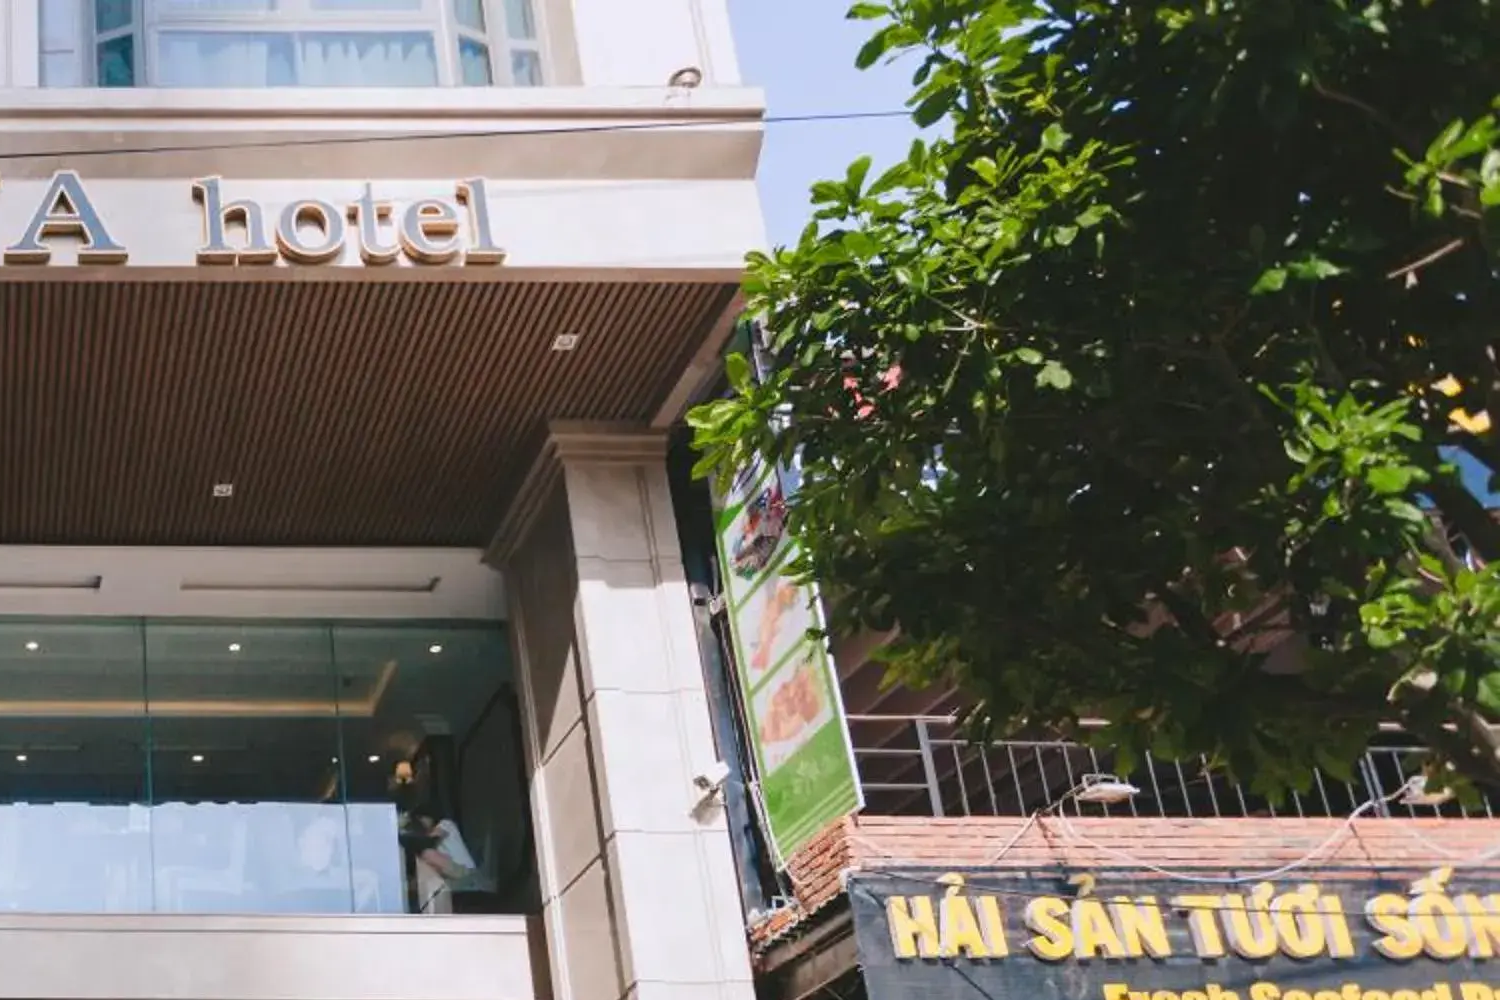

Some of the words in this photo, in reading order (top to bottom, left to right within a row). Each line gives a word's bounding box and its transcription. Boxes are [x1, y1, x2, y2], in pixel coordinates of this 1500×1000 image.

[192, 175, 506, 265] hotel
[886, 872, 1008, 958] HẢI
[1025, 873, 1171, 960] SẢN
[1170, 881, 1355, 958] TƯƠI
